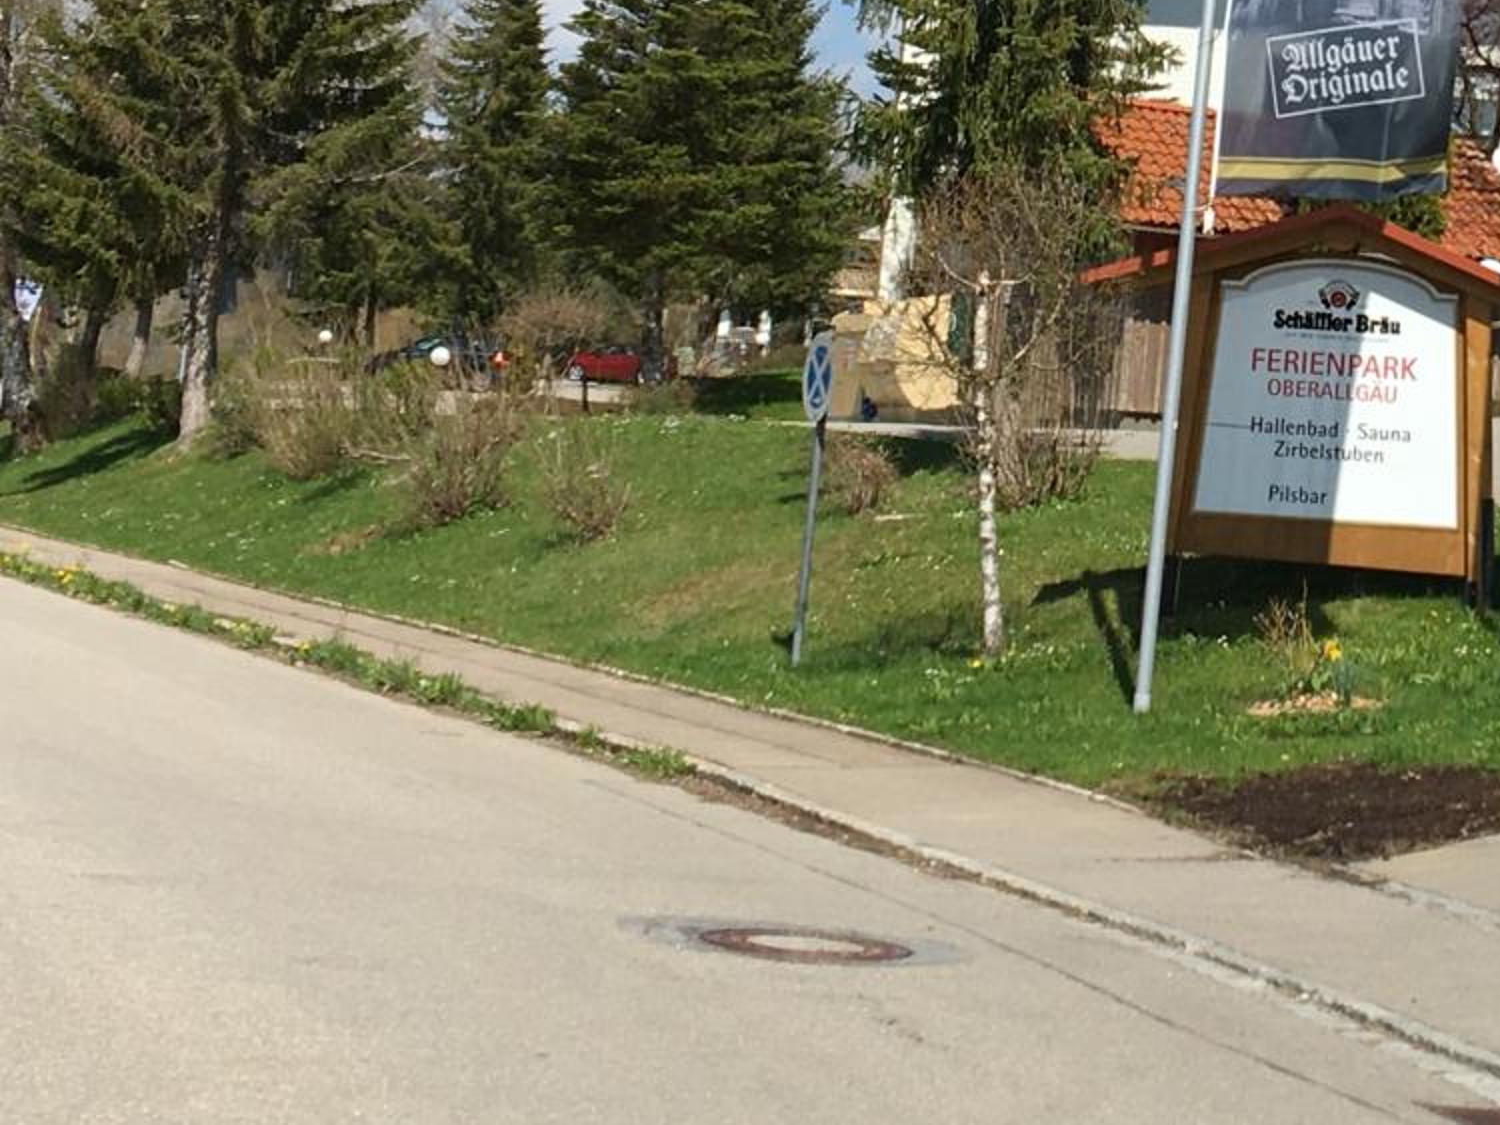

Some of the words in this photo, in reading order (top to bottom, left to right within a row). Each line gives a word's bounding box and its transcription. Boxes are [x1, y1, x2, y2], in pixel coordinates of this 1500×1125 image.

[1281, 35, 1400, 74] Allgäuer
[1281, 61, 1409, 104] Originale
[1355, 313, 1401, 335] Bräu
[1251, 348, 1418, 380] FERIENPARK
[1250, 416, 1339, 438] Hallenbad
[1357, 423, 1412, 443] Sauna
[1273, 441, 1385, 464] Zirbelstuben
[1267, 484, 1328, 505] Pilsbar
